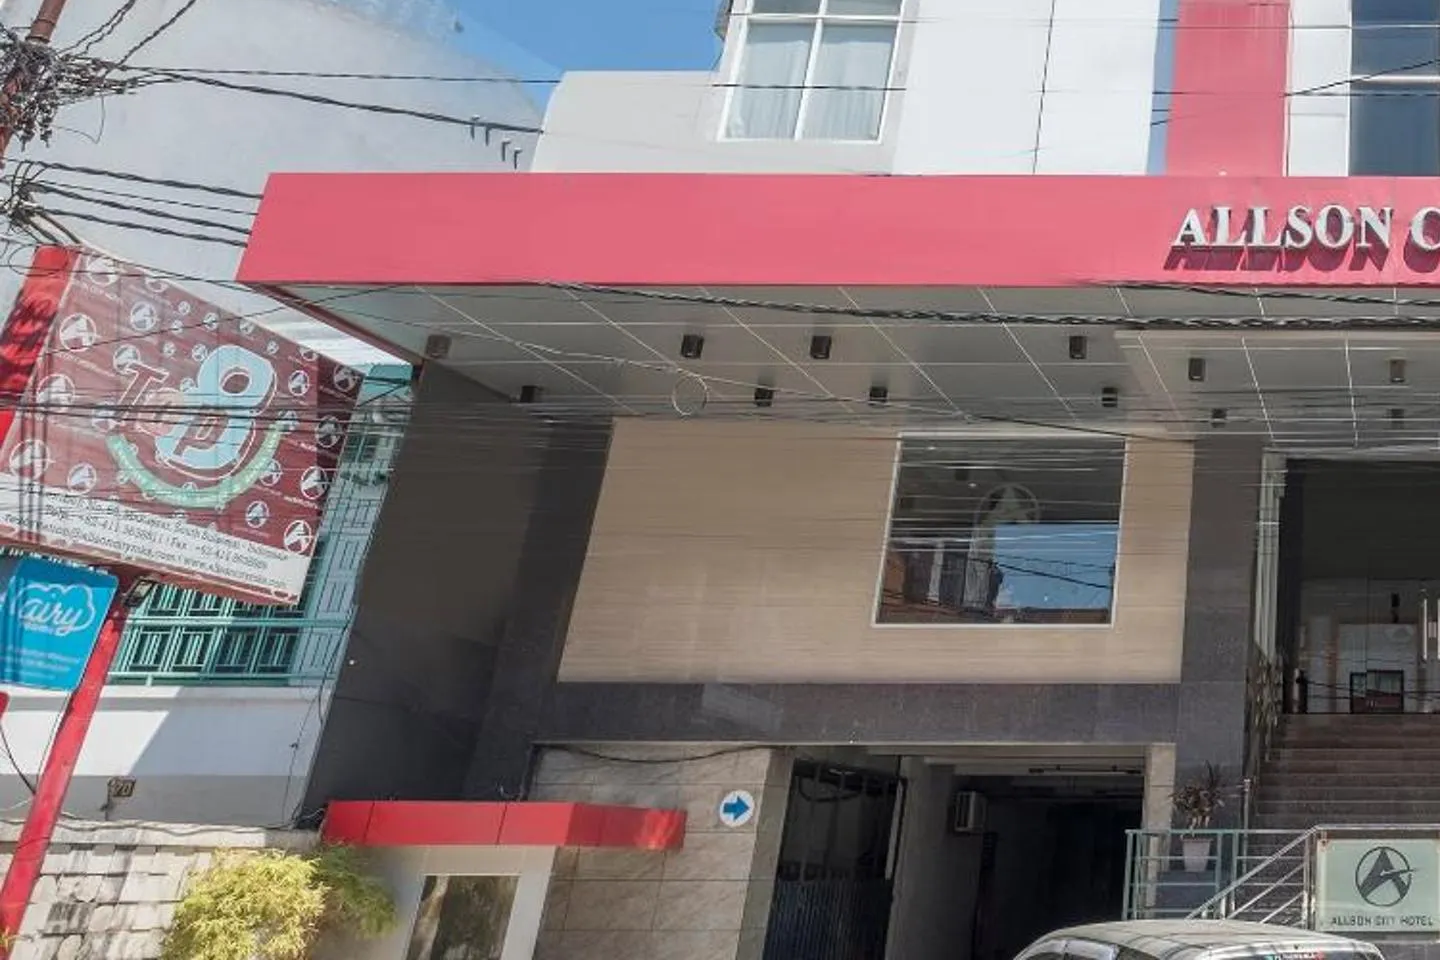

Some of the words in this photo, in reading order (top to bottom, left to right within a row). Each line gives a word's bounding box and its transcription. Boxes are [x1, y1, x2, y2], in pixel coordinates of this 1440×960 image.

[1170, 204, 1396, 251] ALLSON
[1330, 915, 1371, 926] ALLSON
[1399, 915, 1433, 926] HOTEL
